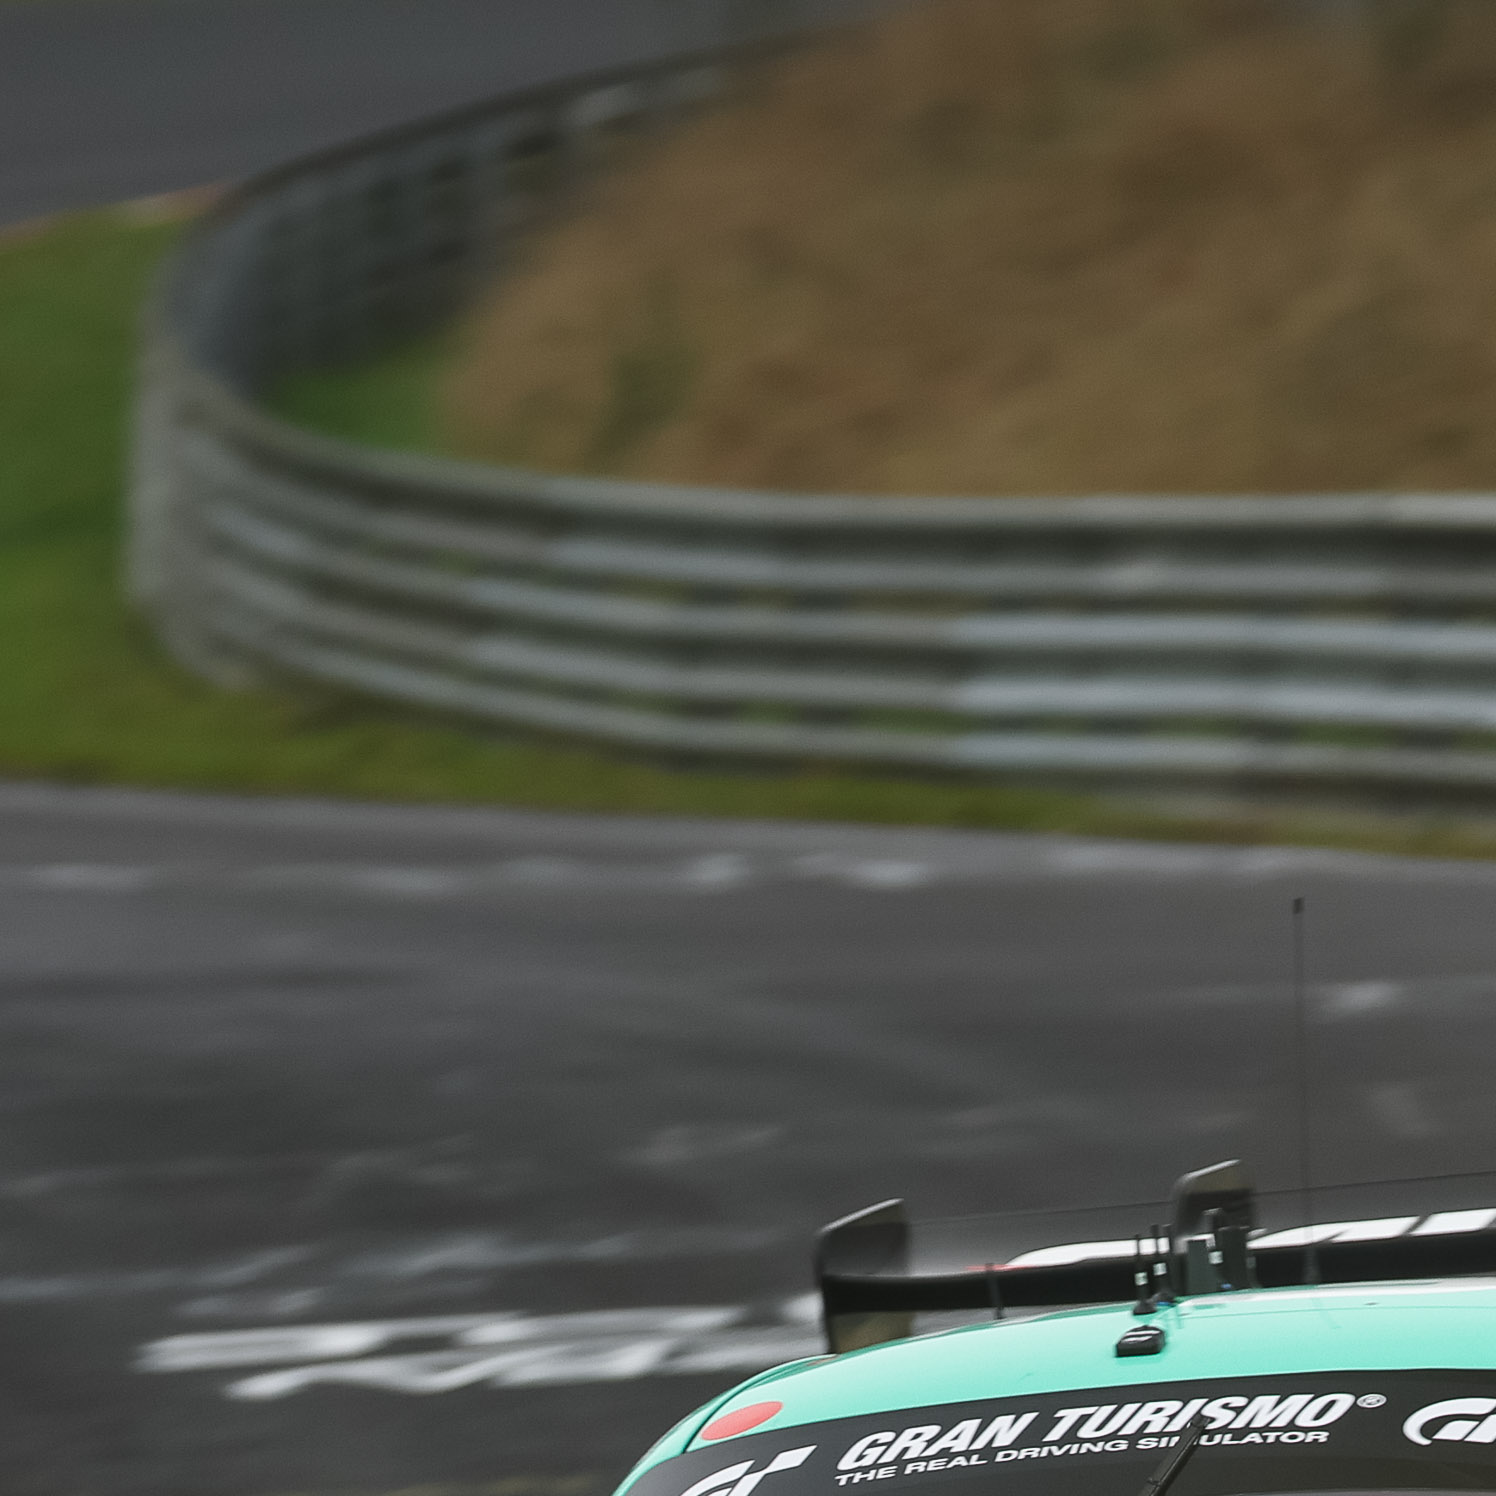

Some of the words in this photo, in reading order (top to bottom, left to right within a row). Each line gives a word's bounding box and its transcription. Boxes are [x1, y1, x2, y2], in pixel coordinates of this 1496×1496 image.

[834, 1466, 897, 1486] THE
[904, 1456, 989, 1475] REAL
[995, 1439, 1129, 1463] DRIVING
[836, 1412, 1040, 1471] GRAN
